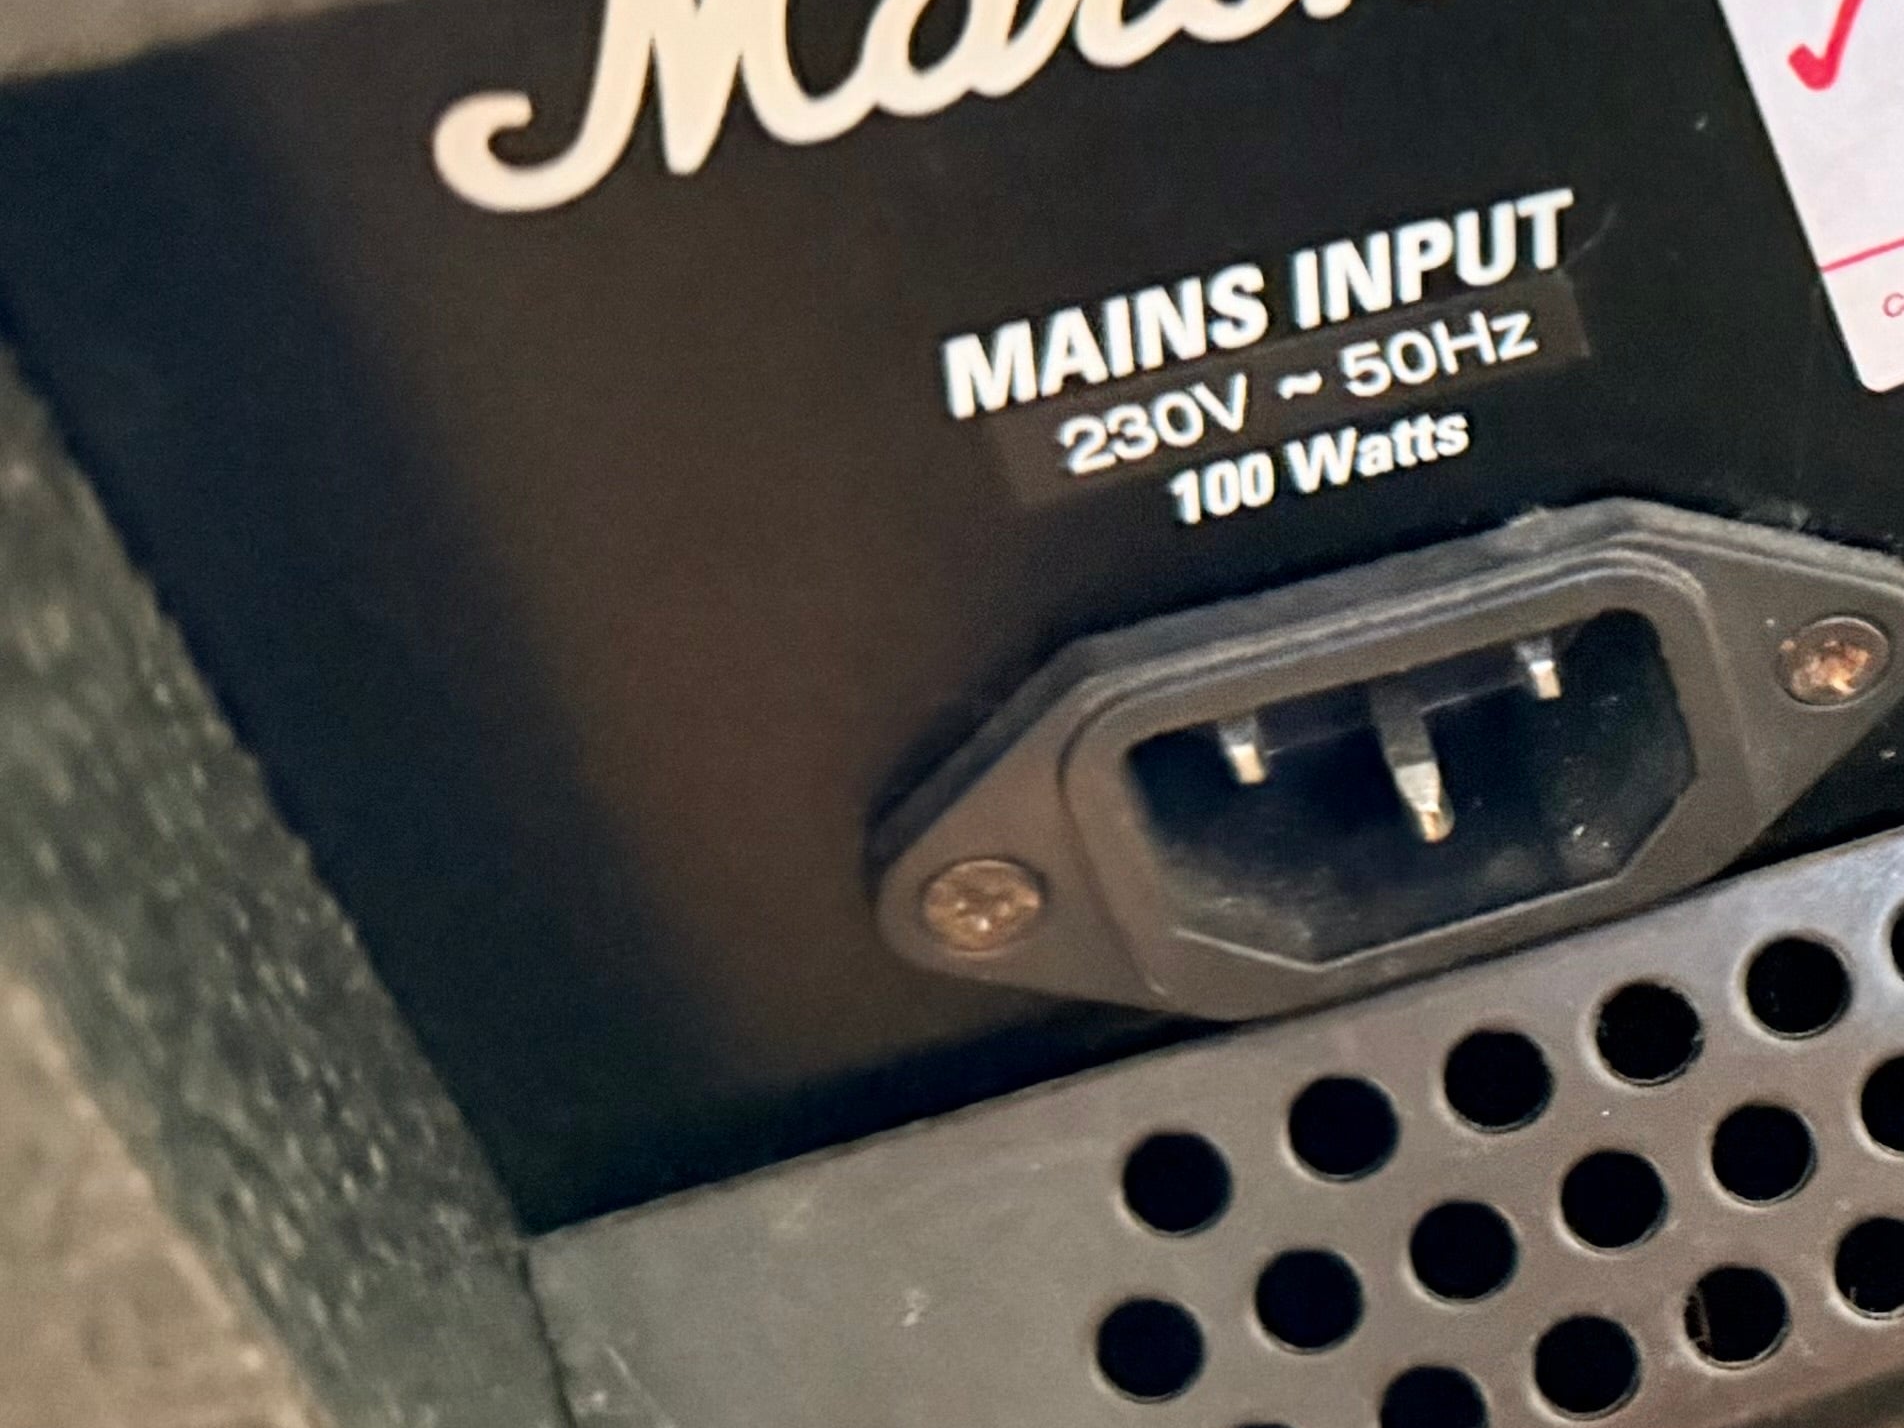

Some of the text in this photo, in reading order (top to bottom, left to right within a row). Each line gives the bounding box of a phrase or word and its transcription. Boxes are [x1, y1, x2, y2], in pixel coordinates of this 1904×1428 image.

[941, 186, 1576, 421] MAINS INPUT
[1056, 371, 1250, 475] 230V
[1337, 307, 1540, 400] 50Hz
[1168, 411, 1473, 527] 100 Watts
